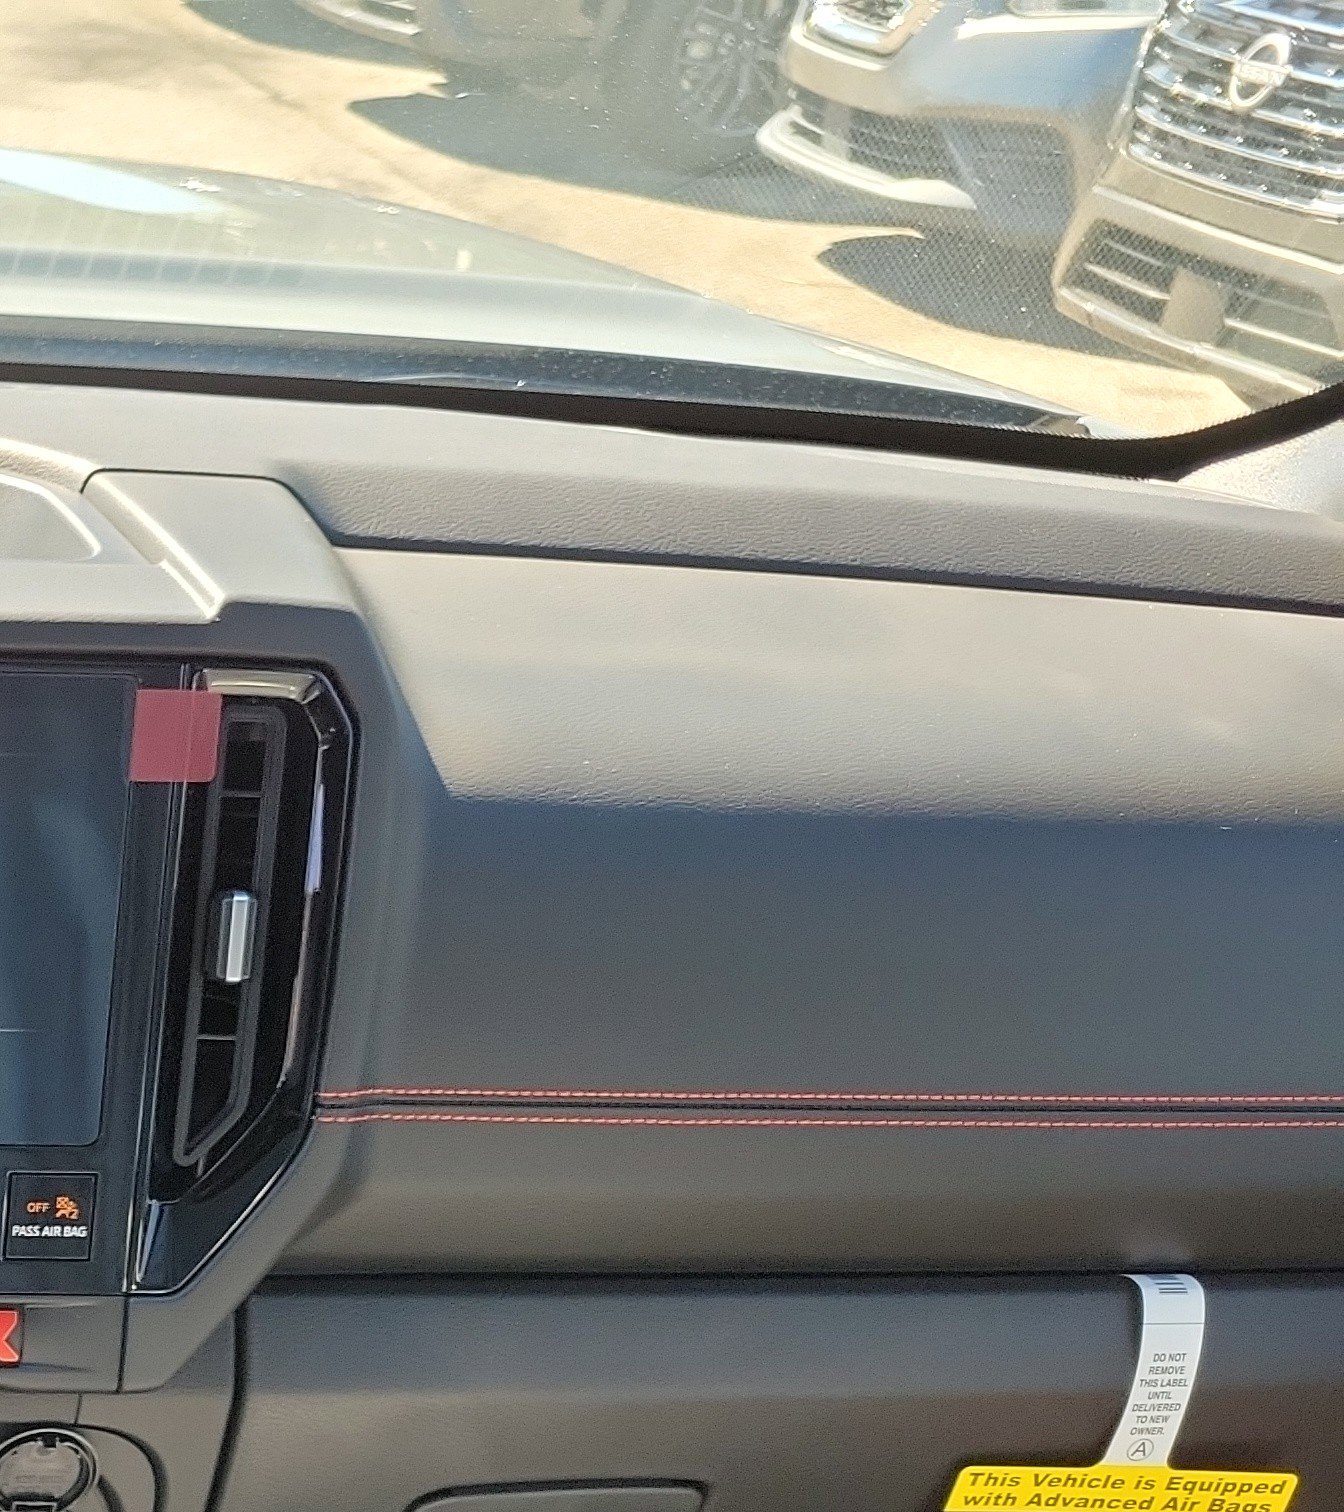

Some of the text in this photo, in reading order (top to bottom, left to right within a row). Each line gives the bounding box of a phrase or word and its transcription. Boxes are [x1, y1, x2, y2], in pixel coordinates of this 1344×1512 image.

[27, 1202, 50, 1213] OFF
[12, 1225, 88, 1237] PASS AIR BAG
[1153, 1353, 1187, 1362] DO NOT
[1148, 1366, 1186, 1375] REMOVE
[1139, 1379, 1188, 1387] THIS LABEL
[1148, 1391, 1172, 1400] UNTIL
[1131, 1403, 1181, 1412] DELIVERED
[1136, 1415, 1170, 1424] TO NEW
[1130, 1427, 1164, 1436] OWNER.
[1131, 1442, 1146, 1457] A
[969, 1472, 1288, 1496] This Vehicle is Equipped
[963, 1492, 1017, 1506] with
[1025, 1493, 1155, 1510] Advanced
[1161, 1497, 1200, 1512] Air
